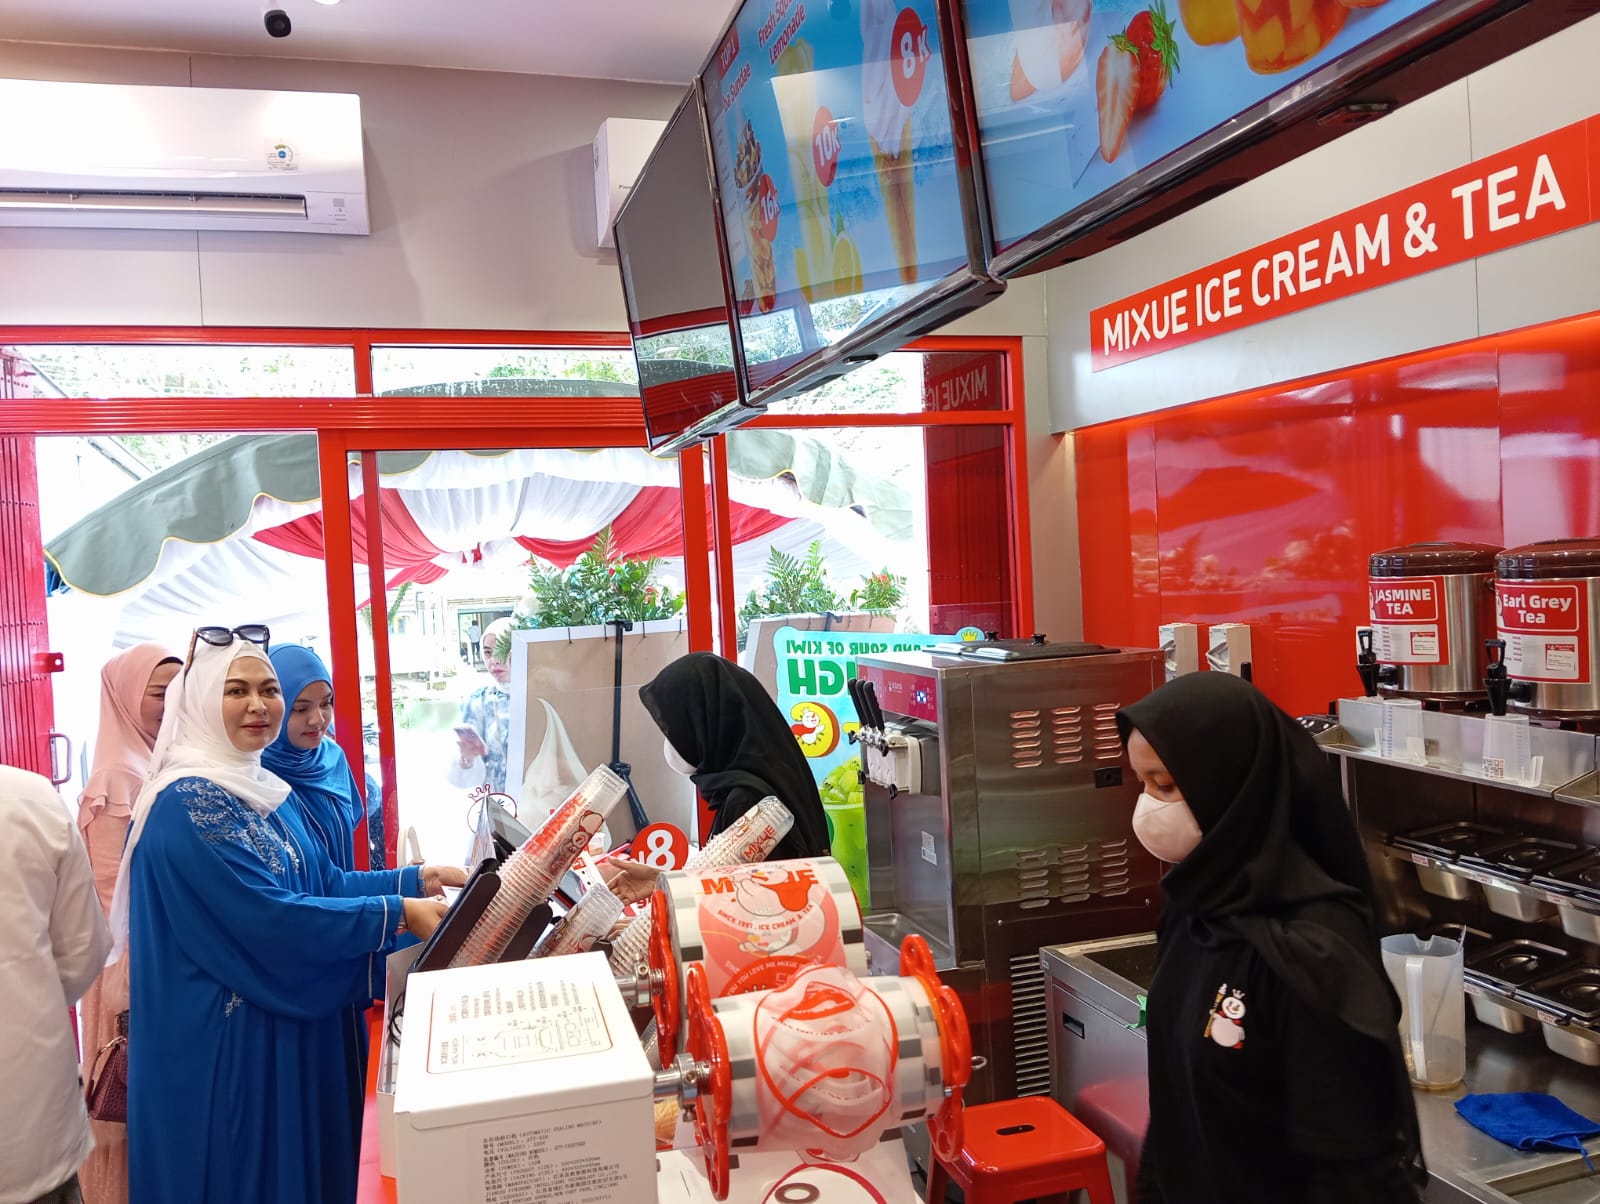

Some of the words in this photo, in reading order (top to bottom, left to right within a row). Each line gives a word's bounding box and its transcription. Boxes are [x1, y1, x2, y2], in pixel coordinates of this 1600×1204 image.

[758, 10, 775, 48] Fresh
[776, 0, 792, 22] Squ
[769, 5, 805, 64] Lemonade
[730, 64, 750, 102] Sundae
[815, 124, 841, 167] 10K
[761, 192, 780, 225] 16K
[1102, 289, 1189, 357] MIXUE
[1196, 269, 1242, 327] ICE
[1252, 214, 1391, 307] CREAM
[1403, 202, 1438, 259] &
[1451, 154, 1566, 241] TEA
[1375, 588, 1431, 604] JASMINE
[1386, 603, 1413, 615] TEA
[1503, 594, 1527, 608] Earl
[1529, 595, 1572, 612] Grey
[1518, 610, 1546, 624] Tea
[743, 824, 776, 858] MIXUE
[717, 909, 736, 924] SINCE
[758, 923, 771, 931] ICE
[772, 917, 796, 931] CREAM
